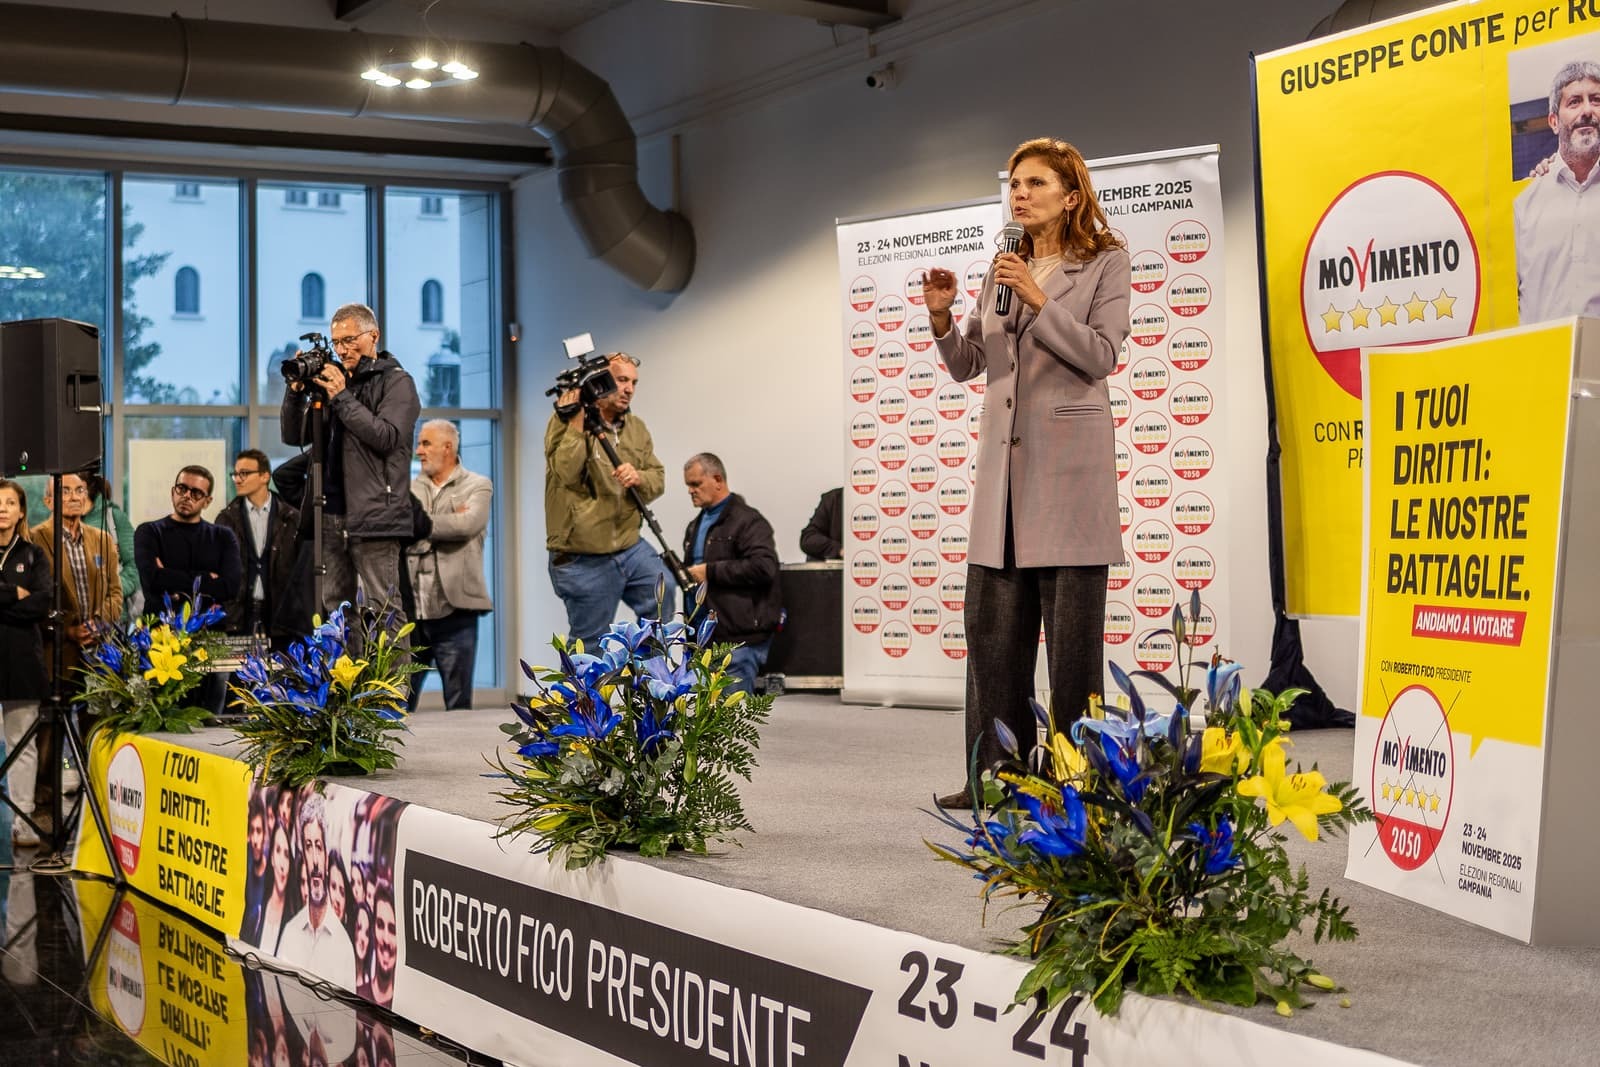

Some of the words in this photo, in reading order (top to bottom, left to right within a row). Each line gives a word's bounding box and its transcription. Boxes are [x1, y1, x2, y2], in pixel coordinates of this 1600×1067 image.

[1281, 39, 1404, 94] GIUSEPPE
[1411, 13, 1505, 62] CONTE
[1514, 7, 1560, 45] per
[1155, 180, 1192, 196] 2025
[1131, 198, 1193, 213] CAMPANIA
[857, 242, 870, 253] 23
[877, 239, 890, 250] 24
[893, 230, 953, 248] NOVEMBRE
[956, 226, 984, 240] 2025
[1171, 233, 1206, 242] MOVIMENTO
[858, 254, 892, 266] ELEZIONI
[894, 248, 937, 261] REGIONALI
[938, 241, 984, 255] CAMPANIA
[1179, 253, 1197, 261] 2050
[1131, 263, 1163, 272] MOVIMENTO
[1318, 238, 1459, 293] MOVIMENTO
[1139, 283, 1155, 291] 2050
[1172, 286, 1207, 295] MOVIMENTO
[1180, 307, 1197, 315] 2050
[1133, 316, 1164, 325] MOVIMENTO
[1173, 341, 1207, 349] MOVIMENTO
[1181, 361, 1198, 369] 2050
[1134, 370, 1165, 379] MOVIMENTO
[1173, 395, 1208, 404] MOVIMENTO
[1395, 391, 1404, 431] I
[1414, 383, 1469, 430] TUOI
[1135, 424, 1167, 433] MOVIMENTO
[1314, 421, 1350, 443] CON
[1175, 450, 1209, 458] MOVIMENTO
[1393, 438, 1491, 486] DIRITTI:
[1184, 470, 1200, 478] 2050
[1136, 479, 1168, 487] MOVIMENTO
[1176, 504, 1210, 513] MOVIMENTO
[1390, 498, 1422, 540] LE
[1427, 494, 1530, 540] NOSTRE
[1137, 533, 1169, 541] MOVIMENTO
[1184, 525, 1201, 533] 2050
[1145, 553, 1160, 561] 2050
[1177, 559, 1211, 568] MOVIMENTO
[1386, 553, 1530, 602] BATTAGLIE.
[1138, 587, 1170, 596] MOVIMENTO
[1146, 608, 1162, 616] 2050
[1415, 611, 1462, 635] ANDIAMO
[1462, 615, 1471, 635] A
[1472, 614, 1515, 639] VOTARE
[1147, 662, 1163, 671] 2050
[1381, 660, 1393, 673] CON
[1393, 661, 1420, 676] ROBERTO
[1421, 665, 1435, 678] FICO
[1435, 667, 1473, 683] PRESIDENTE
[1382, 735, 1446, 778] MOVIMENTO
[163, 750, 170, 775] I
[171, 752, 200, 784] TUOI
[109, 779, 142, 810] MOVIMENTO
[160, 788, 210, 827] DIRITTI:
[1463, 823, 1473, 838] 23
[1477, 826, 1487, 841] 24
[158, 826, 175, 856] LE
[178, 831, 228, 876] NOSTRE
[1391, 826, 1421, 861] 2050
[1462, 841, 1502, 865] NOVEMBRE
[1502, 852, 1522, 870] 2025
[1460, 864, 1488, 882] ELEZIONI
[1488, 872, 1522, 894] REGIONALI
[158, 864, 225, 919] BATTAGLIE.
[1458, 878, 1492, 899] CAMPANIA
[413, 879, 511, 977] ROBERTO
[517, 914, 574, 1001] FICO
[587, 938, 811, 1067] PRESIDENTE
[898, 950, 965, 1029] 23
[1012, 986, 1089, 1067] 24
